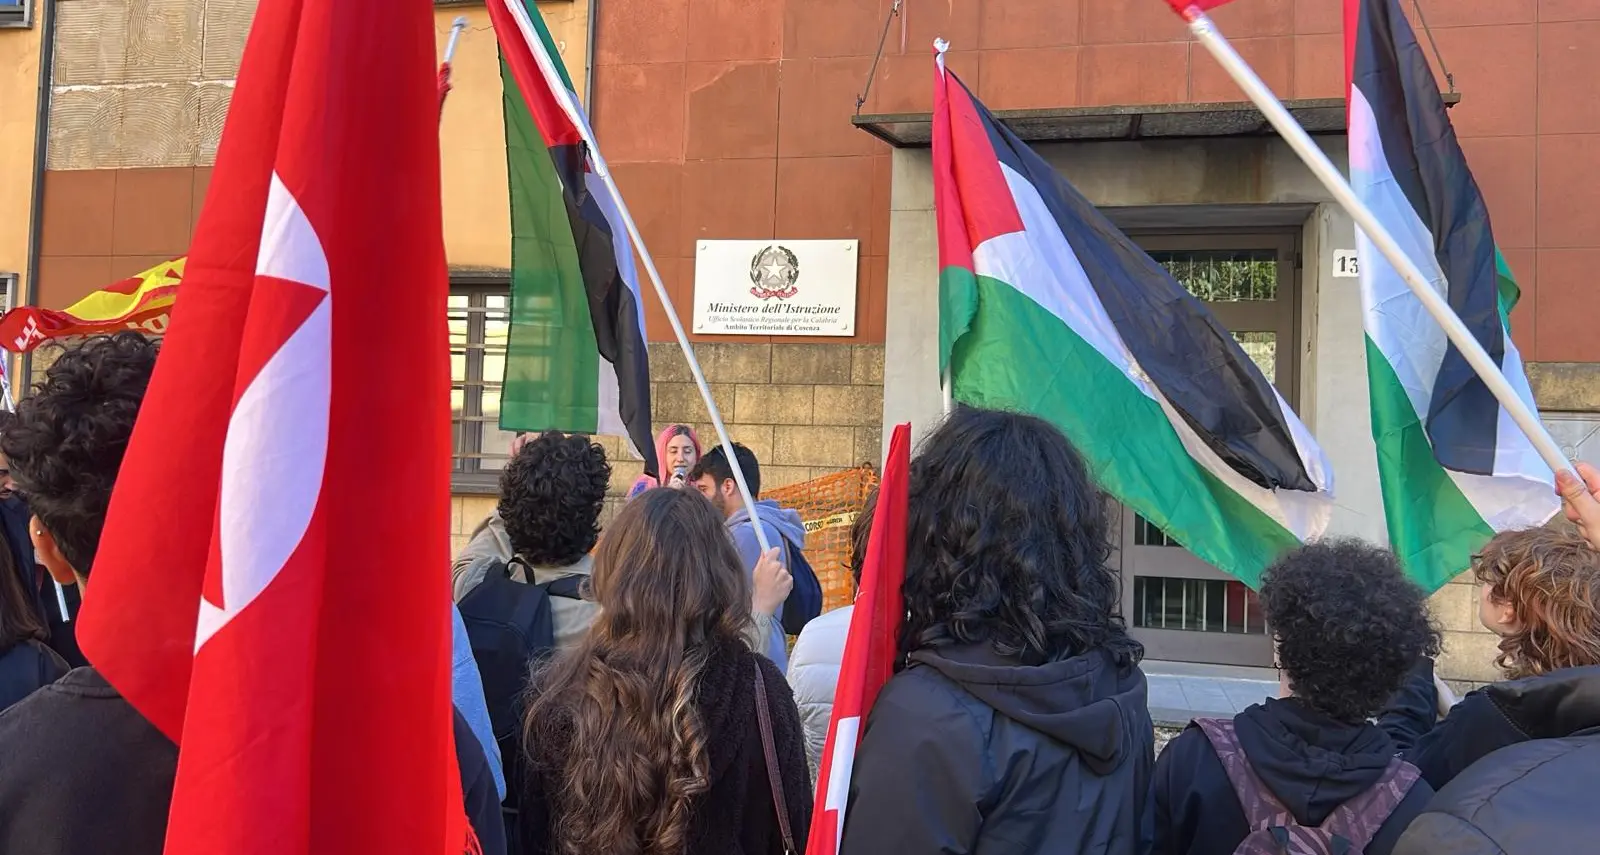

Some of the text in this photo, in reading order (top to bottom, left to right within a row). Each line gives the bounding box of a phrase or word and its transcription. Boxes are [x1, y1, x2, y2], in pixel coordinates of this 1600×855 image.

[1337, 256, 1359, 274] 13
[707, 302, 841, 315] Ministero dell'Istruzione
[708, 315, 729, 323] Ufficio
[760, 316, 790, 324] Regionale
[810, 316, 838, 324] Calabria
[749, 323, 785, 331] Territoriale
